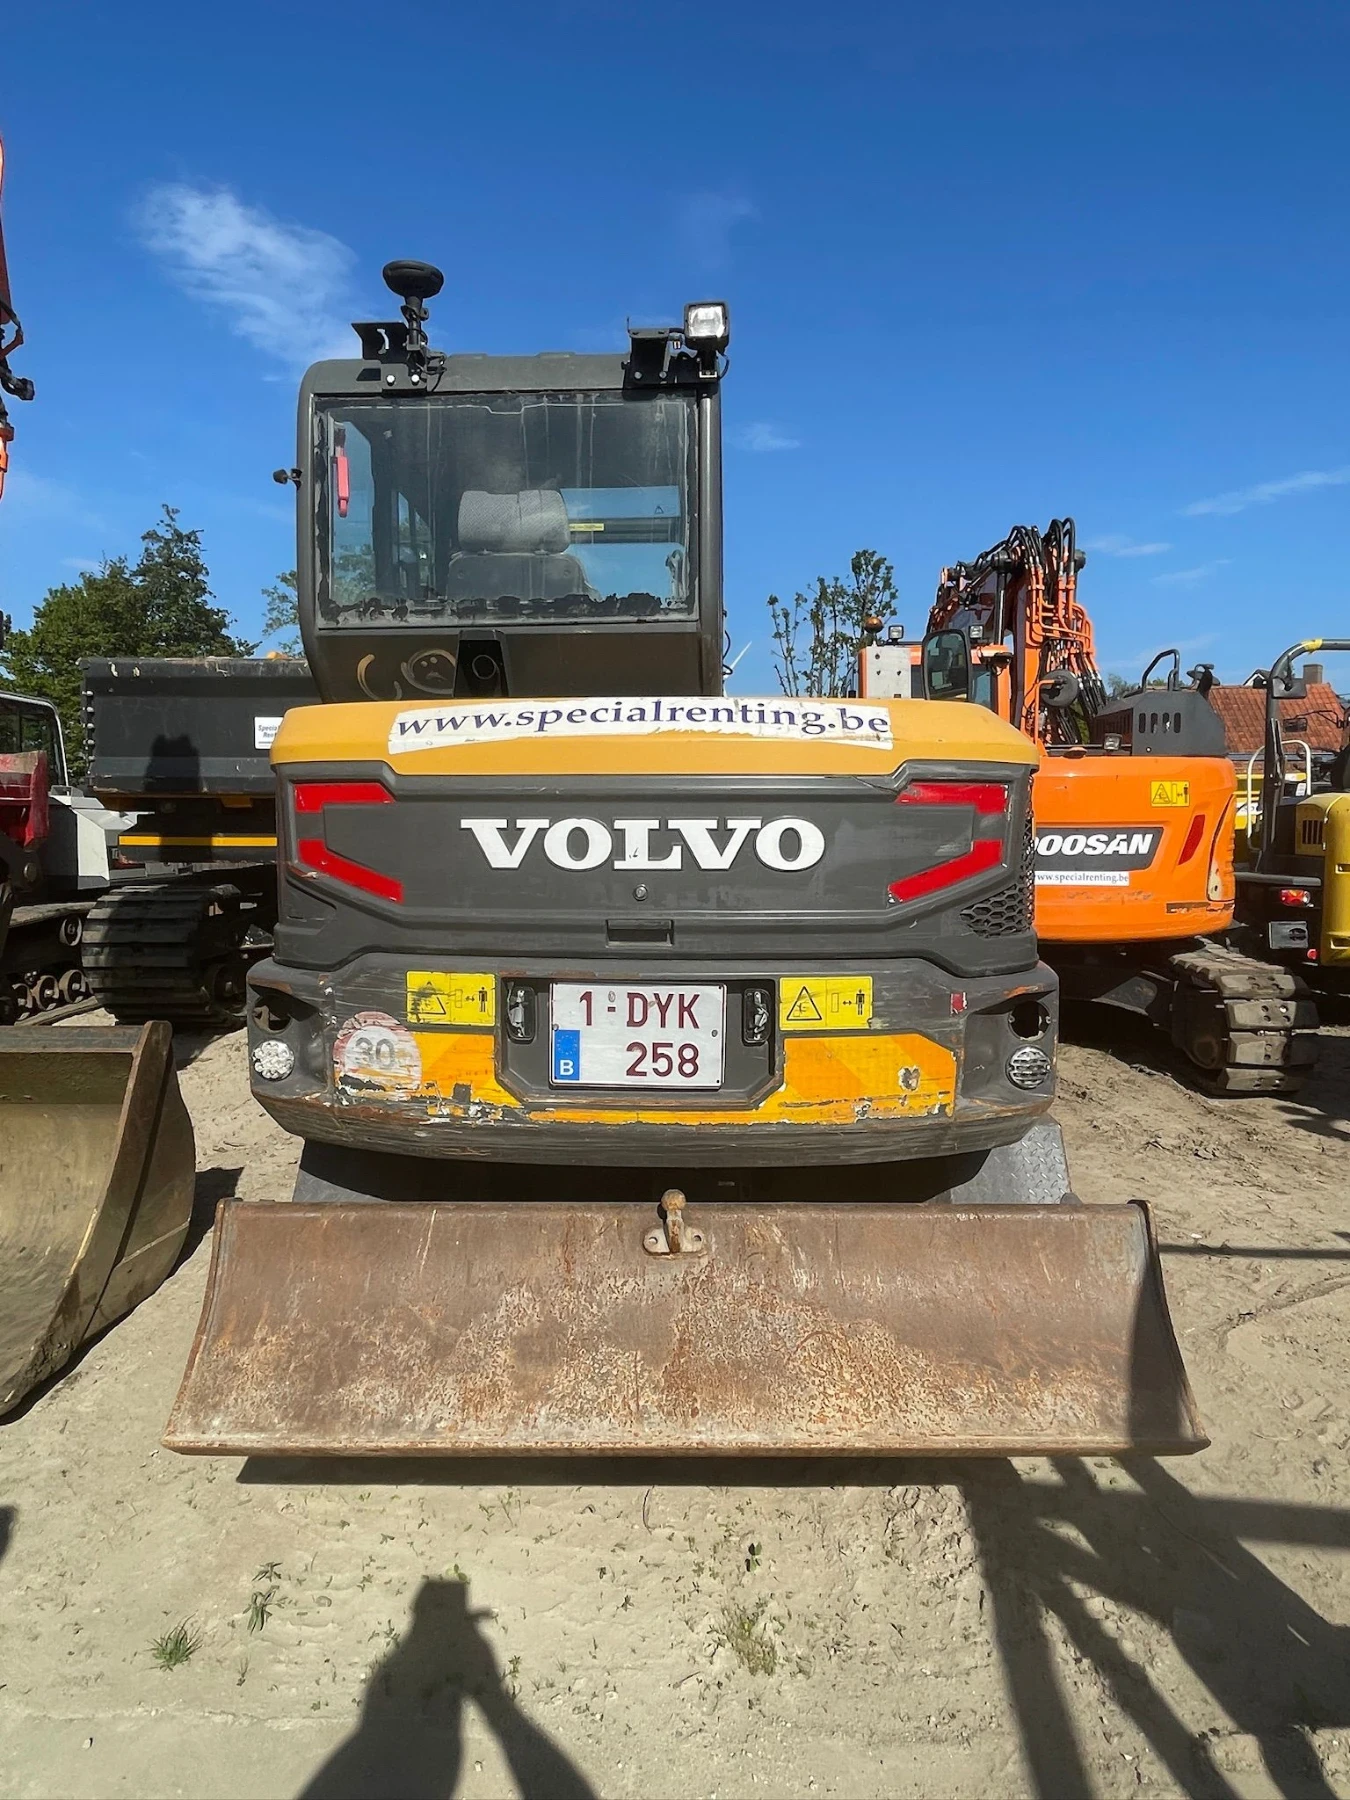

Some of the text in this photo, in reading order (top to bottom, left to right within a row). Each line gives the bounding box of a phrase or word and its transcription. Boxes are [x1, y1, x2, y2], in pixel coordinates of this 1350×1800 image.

[258, 724, 279, 732] Specia
[397, 699, 889, 736] www.specialrenting.be
[460, 817, 826, 871] VOLVO
[1034, 833, 1154, 856] OOSAN
[1034, 872, 1128, 883] ww.specialrenting.be
[559, 1059, 574, 1076] B
[626, 1041, 699, 1078] 258
